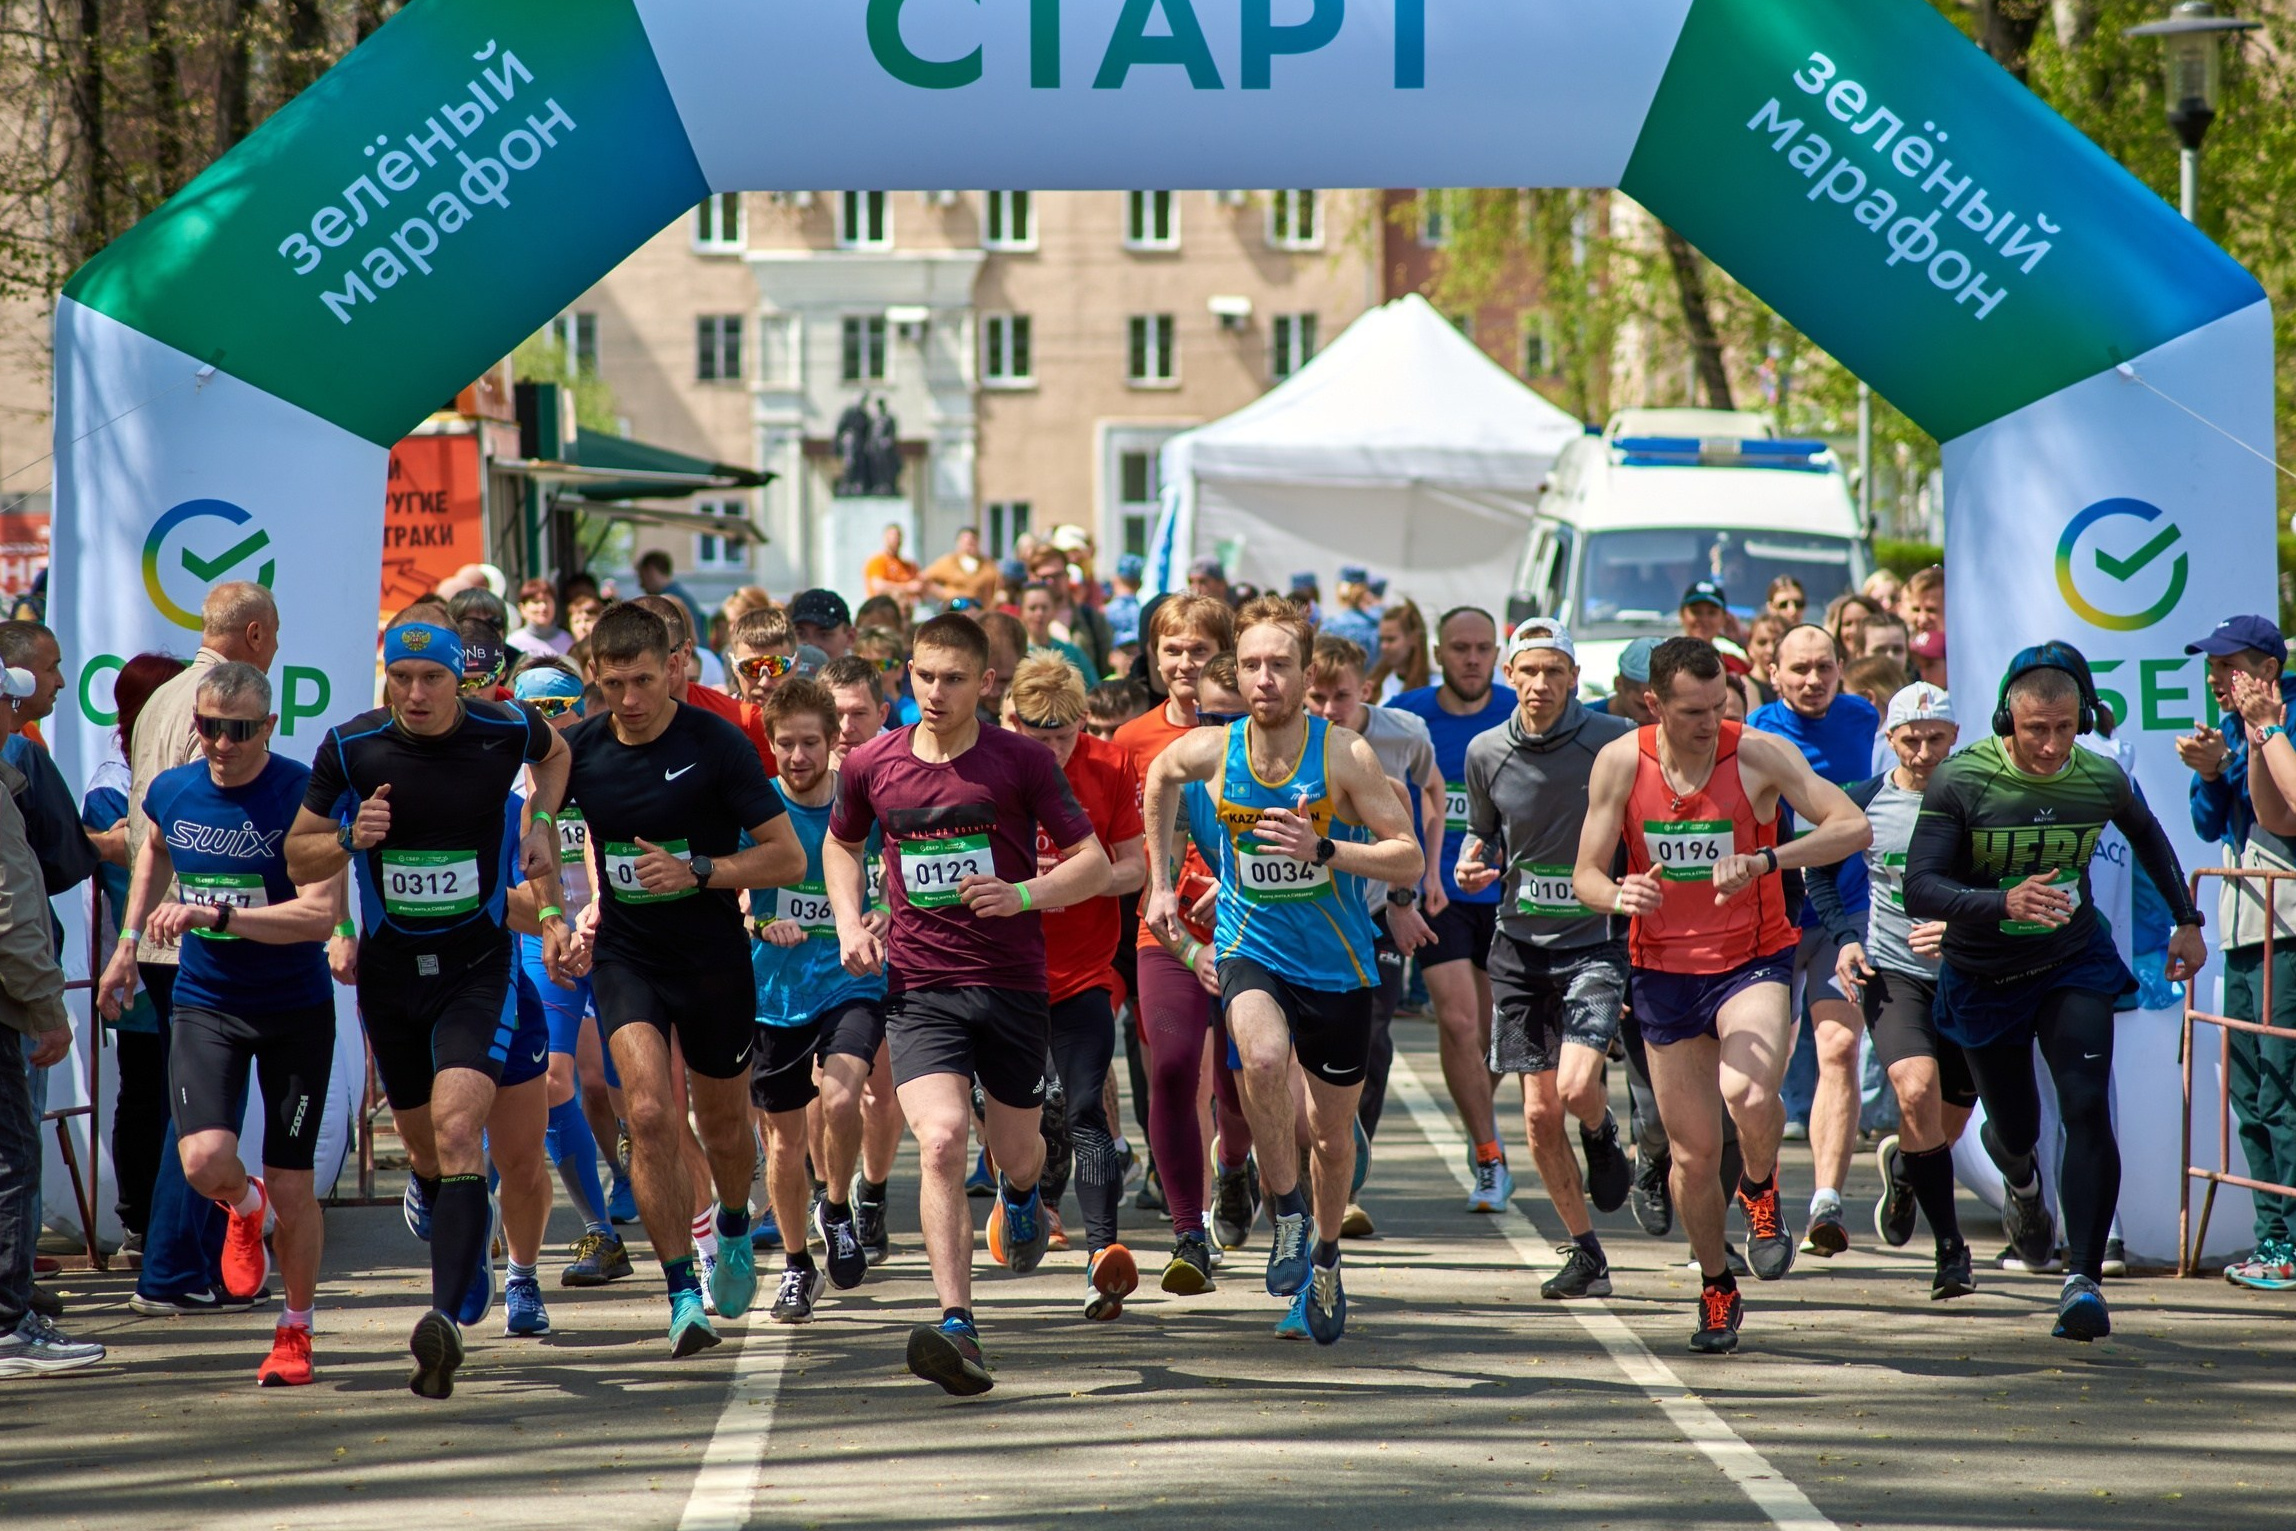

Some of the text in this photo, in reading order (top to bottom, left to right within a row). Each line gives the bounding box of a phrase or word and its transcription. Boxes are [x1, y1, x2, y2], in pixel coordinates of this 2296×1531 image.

[278, 38, 535, 276] зелёный
[1793, 51, 2061, 274] зелёный
[319, 98, 578, 325] марафон
[1746, 98, 2008, 321] марафон
[386, 490, 448, 514] УГИЕ
[384, 523, 454, 548] ТРАКИ
[79, 653, 331, 737] СР
[1229, 812, 1320, 824] KAZAN
[1446, 798, 1466, 815] 70
[562, 826, 585, 844] 18
[911, 830, 929, 839] ALL
[936, 828, 948, 836] OR
[1658, 840, 1719, 860] 0196
[2092, 840, 2126, 867] АСС
[392, 871, 458, 895] 0312
[916, 859, 979, 885] 0123
[1252, 861, 1315, 883] 0034
[790, 898, 836, 920] 036
[1379, 952, 1401, 965] FILA
